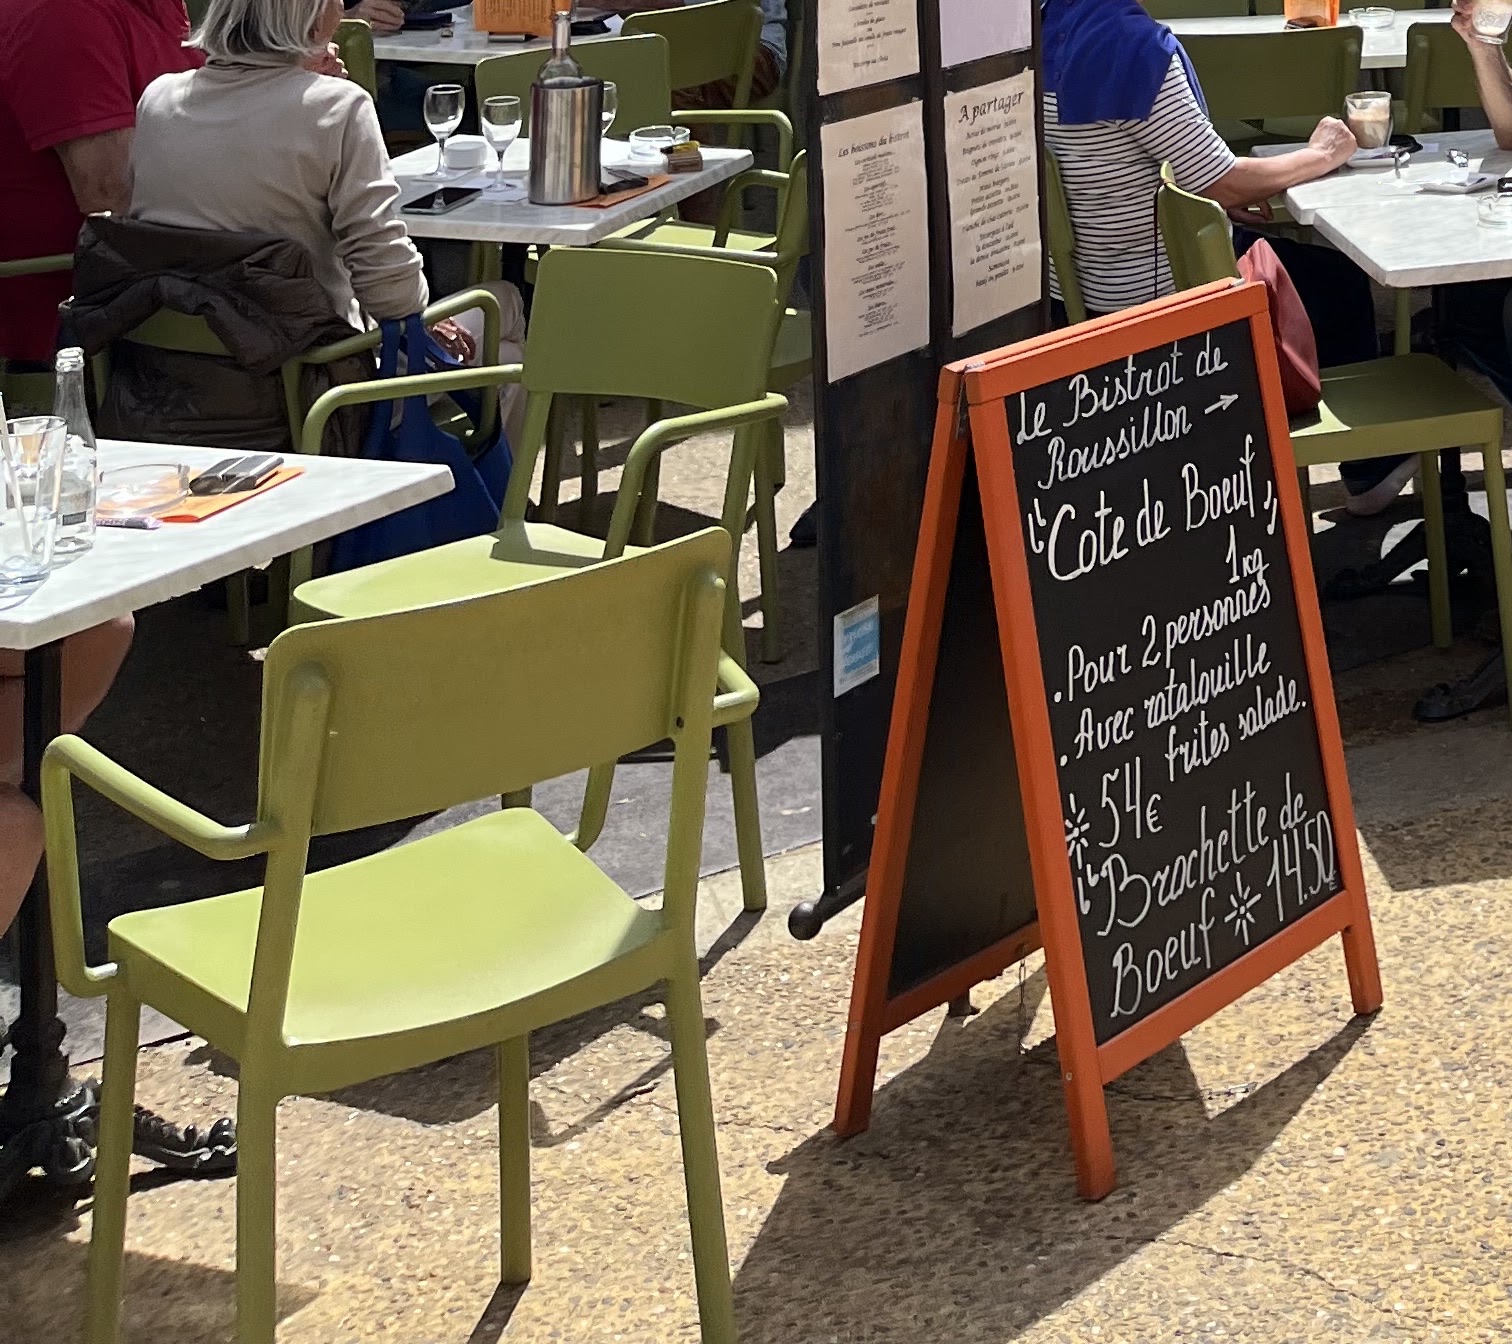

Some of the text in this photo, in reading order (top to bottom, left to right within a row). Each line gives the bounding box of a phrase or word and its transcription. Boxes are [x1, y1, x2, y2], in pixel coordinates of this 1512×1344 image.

[969, 91, 1025, 126] partager
[1017, 331, 1229, 445] Le Bistrot de
[1038, 401, 1193, 490] Roussillon
[1136, 478, 1172, 547] de
[1068, 578, 1271, 702] Pour 2 personnes
[1073, 707, 1134, 760] Avec
[1164, 710, 1230, 782] frites
[1098, 756, 1163, 848] 54€
[1280, 772, 1308, 831] de
[1110, 887, 1216, 1018] Boeuf
